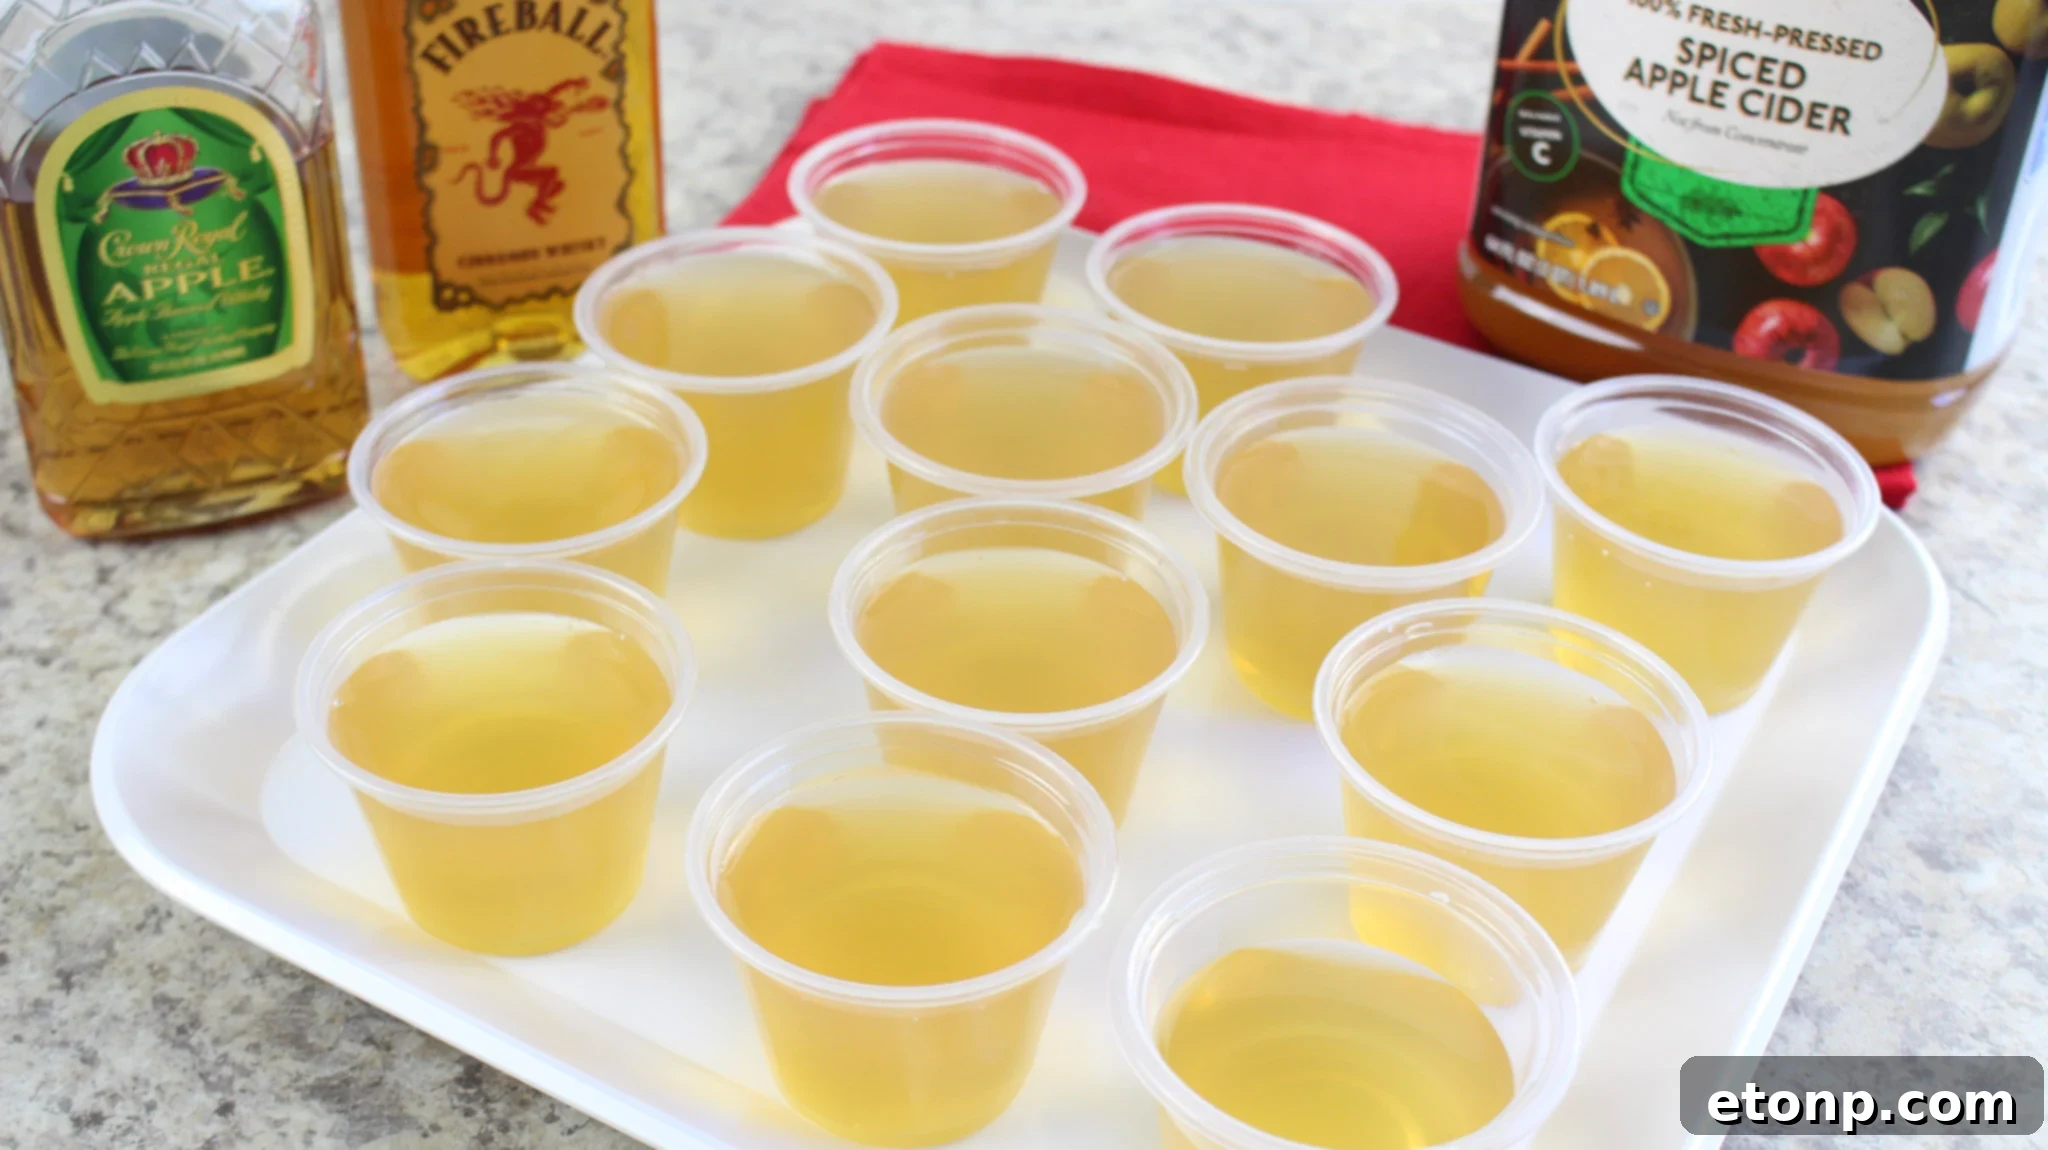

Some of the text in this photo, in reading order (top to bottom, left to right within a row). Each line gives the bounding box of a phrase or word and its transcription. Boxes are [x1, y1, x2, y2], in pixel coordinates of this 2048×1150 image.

[420, 0, 609, 75] FIREBALL
[1626, 0, 1883, 62] 0% FRESH-PRESSED
[1676, 36, 1808, 90] SPICED
[1624, 57, 1852, 136] APPLE CIDER
[1531, 140, 1552, 167] C
[97, 210, 248, 267] Crown Royal
[104, 254, 276, 306] APPLE
